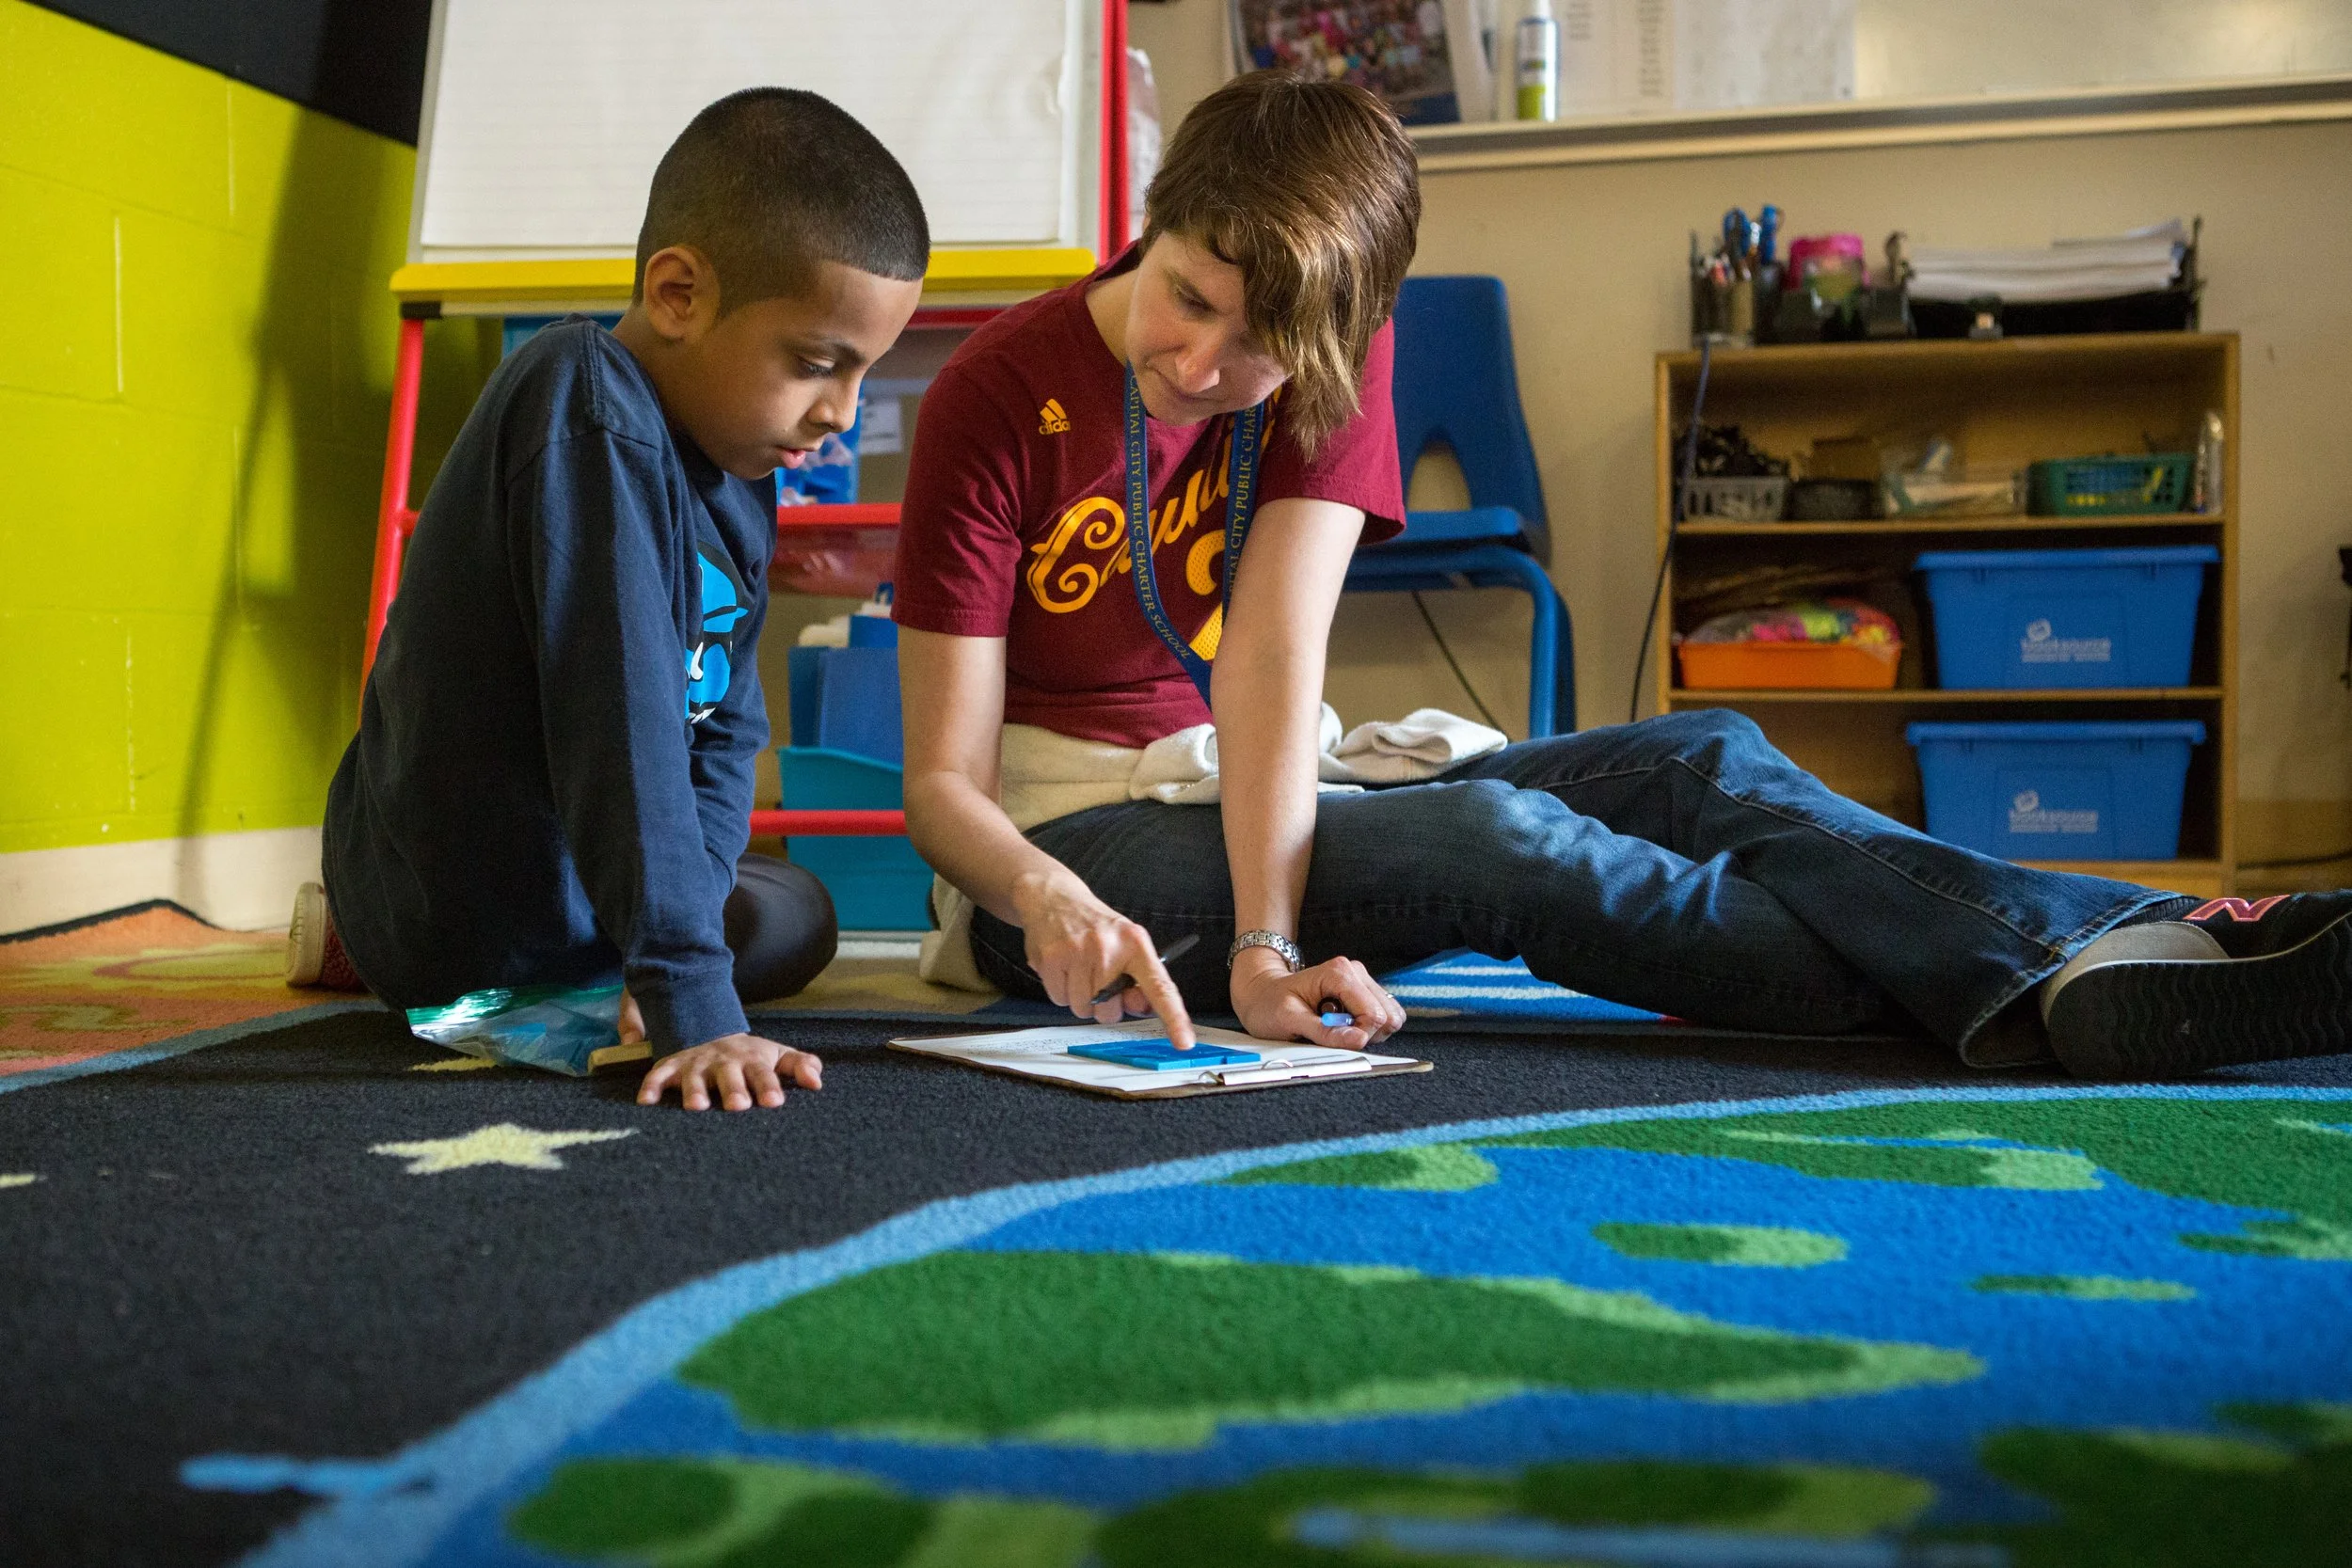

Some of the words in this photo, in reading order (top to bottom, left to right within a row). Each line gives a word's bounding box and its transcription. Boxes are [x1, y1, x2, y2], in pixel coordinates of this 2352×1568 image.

[1130, 375, 1140, 438] CAPITAL
[1242, 406, 1257, 451] CHAR
[1131, 441, 1141, 477] CITY
[1235, 455, 1253, 509] PUBLIC
[1132, 482, 1144, 537] PUBLIC
[1231, 513, 1246, 549] CITY
[1135, 540, 1156, 611] CHARTER
[1150, 613, 1191, 658] SCHOOL
